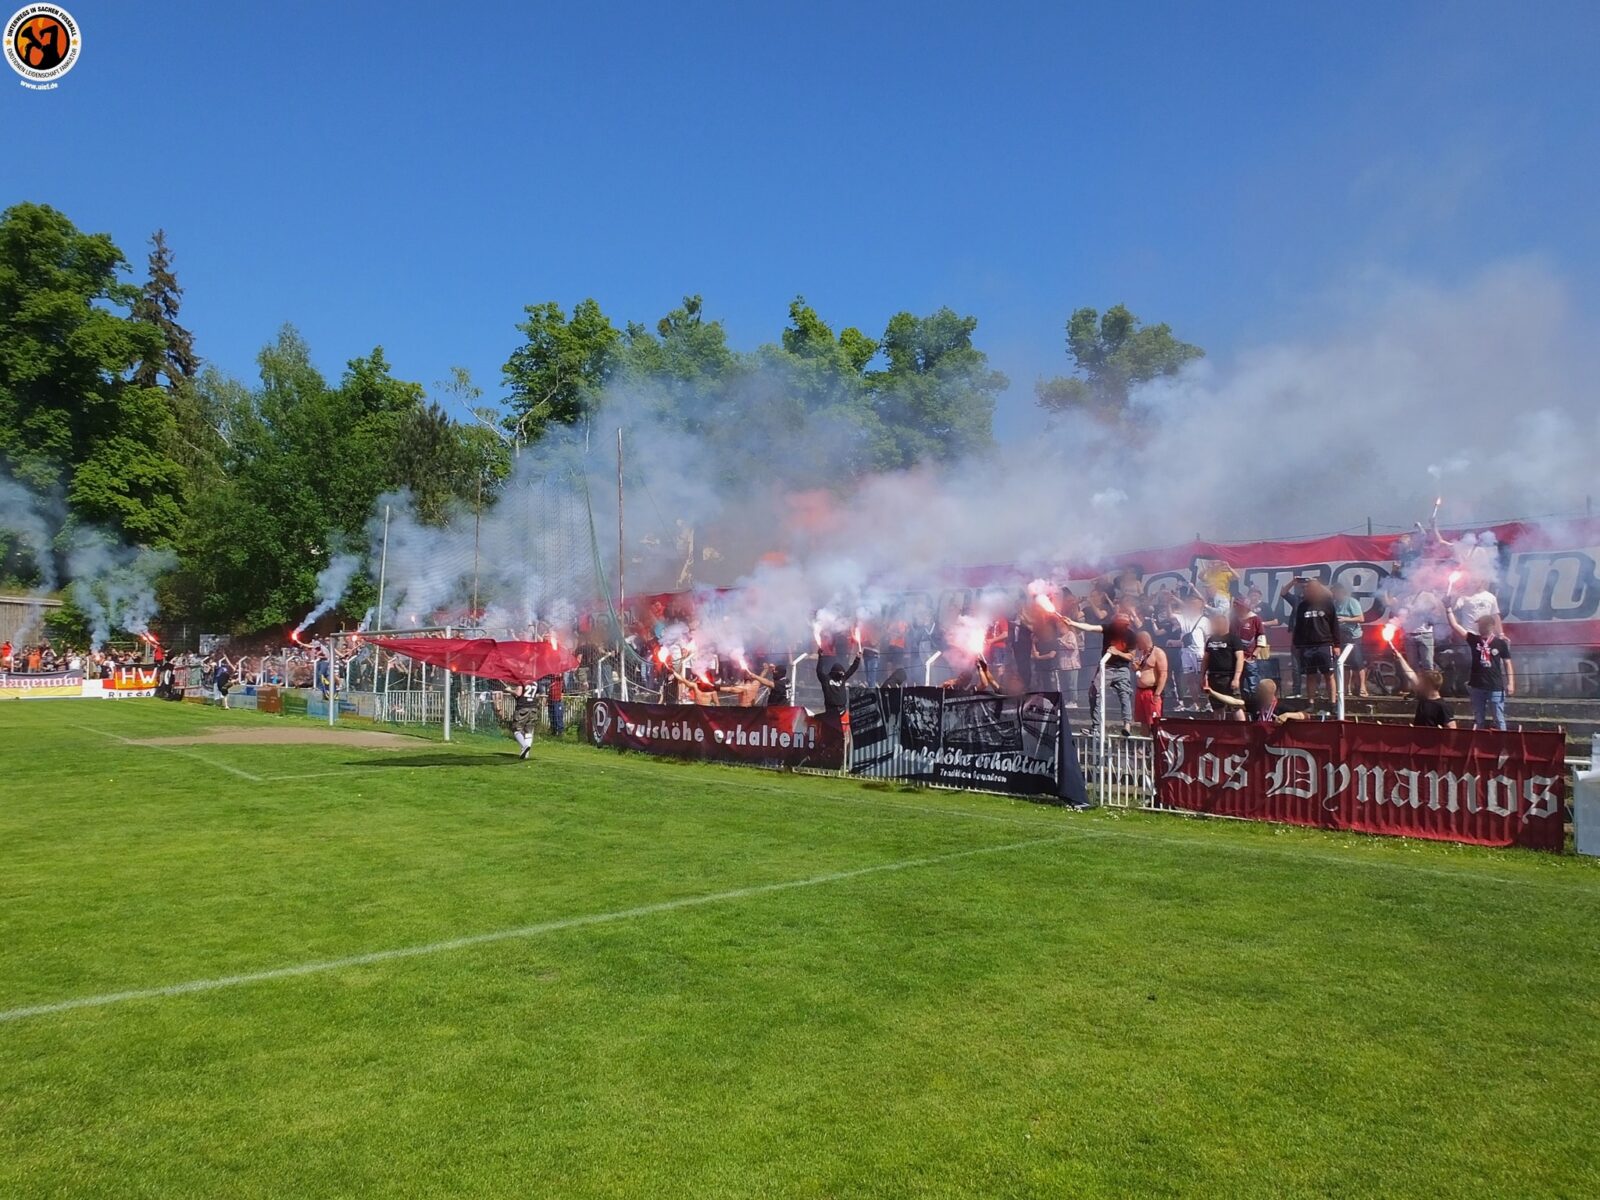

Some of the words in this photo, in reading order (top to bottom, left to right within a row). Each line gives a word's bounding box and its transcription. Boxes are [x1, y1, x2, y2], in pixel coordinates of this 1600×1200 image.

[122, 667, 158, 685] HW
[524, 685, 538, 699] 27
[617, 715, 705, 742] Paulshöhe
[714, 724, 815, 749] erhalten!
